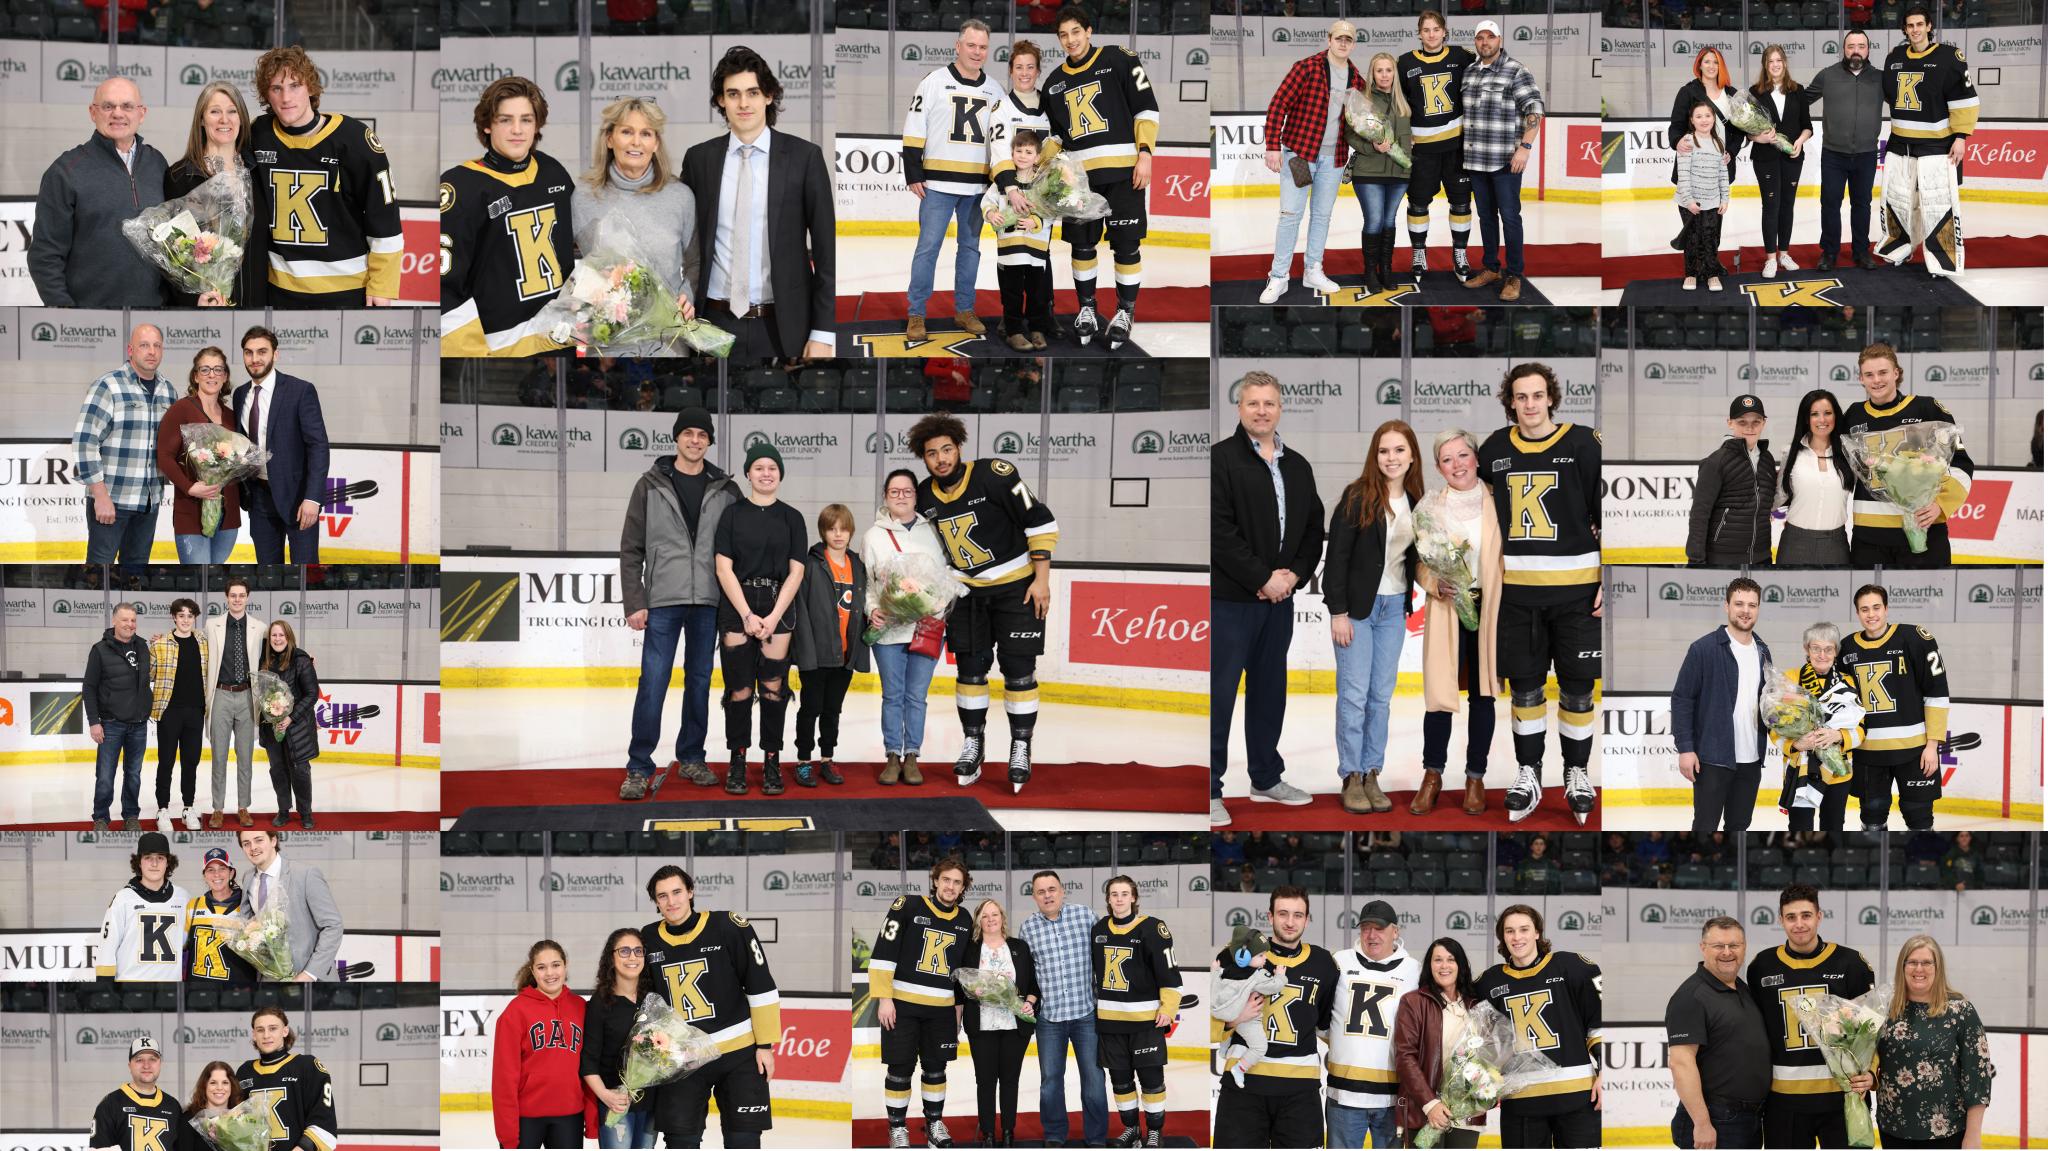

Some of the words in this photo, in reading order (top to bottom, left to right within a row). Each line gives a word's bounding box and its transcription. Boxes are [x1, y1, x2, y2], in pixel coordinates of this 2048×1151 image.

[1998, 36, 2042, 48] kawartha
[332, 68, 395, 82] kawartha
[600, 61, 690, 81] kawartha
[599, 82, 631, 92] CREDIT
[633, 82, 668, 91] UNION
[1895, 71, 1925, 112] K
[1420, 72, 1454, 117] K
[1064, 80, 1110, 141] K
[947, 94, 991, 146] K
[1967, 141, 2037, 166] Kehoe
[548, 185, 566, 194] CCM
[269, 169, 329, 246] K
[1109, 218, 1140, 227] CCM
[505, 202, 563, 301] K
[60, 323, 117, 338] kawartha
[167, 325, 221, 339] kawartha
[1668, 363, 1717, 375] kawartha
[1761, 364, 1809, 376] kawartha
[1414, 379, 1491, 397] kawartha
[1295, 397, 1323, 405] UNION
[1413, 397, 1441, 405] CREDIT
[1443, 397, 1472, 405] UNION
[1565, 396, 1592, 405] CREDIT
[525, 440, 550, 448] CREDIT
[774, 432, 838, 447] kawartha
[797, 446, 822, 454] UNION
[1053, 447, 1079, 455] UNION
[1168, 446, 1195, 454] CREDIT
[968, 496, 987, 506] CCM
[1507, 471, 1559, 541] K
[938, 511, 996, 570] K
[1787, 585, 1839, 597] kawartha
[1889, 584, 1943, 597] kawartha
[526, 616, 598, 628] TRUCKING
[1091, 605, 1210, 645] Kehoe
[1009, 631, 1042, 639] CCM
[1898, 656, 1908, 675] A
[1854, 661, 1896, 714] K
[328, 729, 362, 746] TV
[1906, 779, 1935, 787] CCM
[457, 872, 515, 886] kawartha
[567, 872, 624, 886] kawartha
[1887, 906, 1944, 919] kawartha
[138, 912, 177, 964] K
[192, 924, 231, 981] K
[916, 927, 957, 977] K
[1102, 945, 1134, 992] K
[1300, 975, 1321, 983] CCM
[1761, 974, 1784, 987] OHL
[662, 958, 715, 1022] K
[1262, 983, 1304, 1046] K
[1344, 979, 1396, 1040] K
[1503, 989, 1560, 1053] K
[198, 1025, 248, 1038] kawartha
[529, 1019, 583, 1054] GAP
[141, 1038, 151, 1048] K
[1134, 1046, 1158, 1055] CCM
[737, 1104, 769, 1113] CCM
[129, 1113, 169, 1151] K
